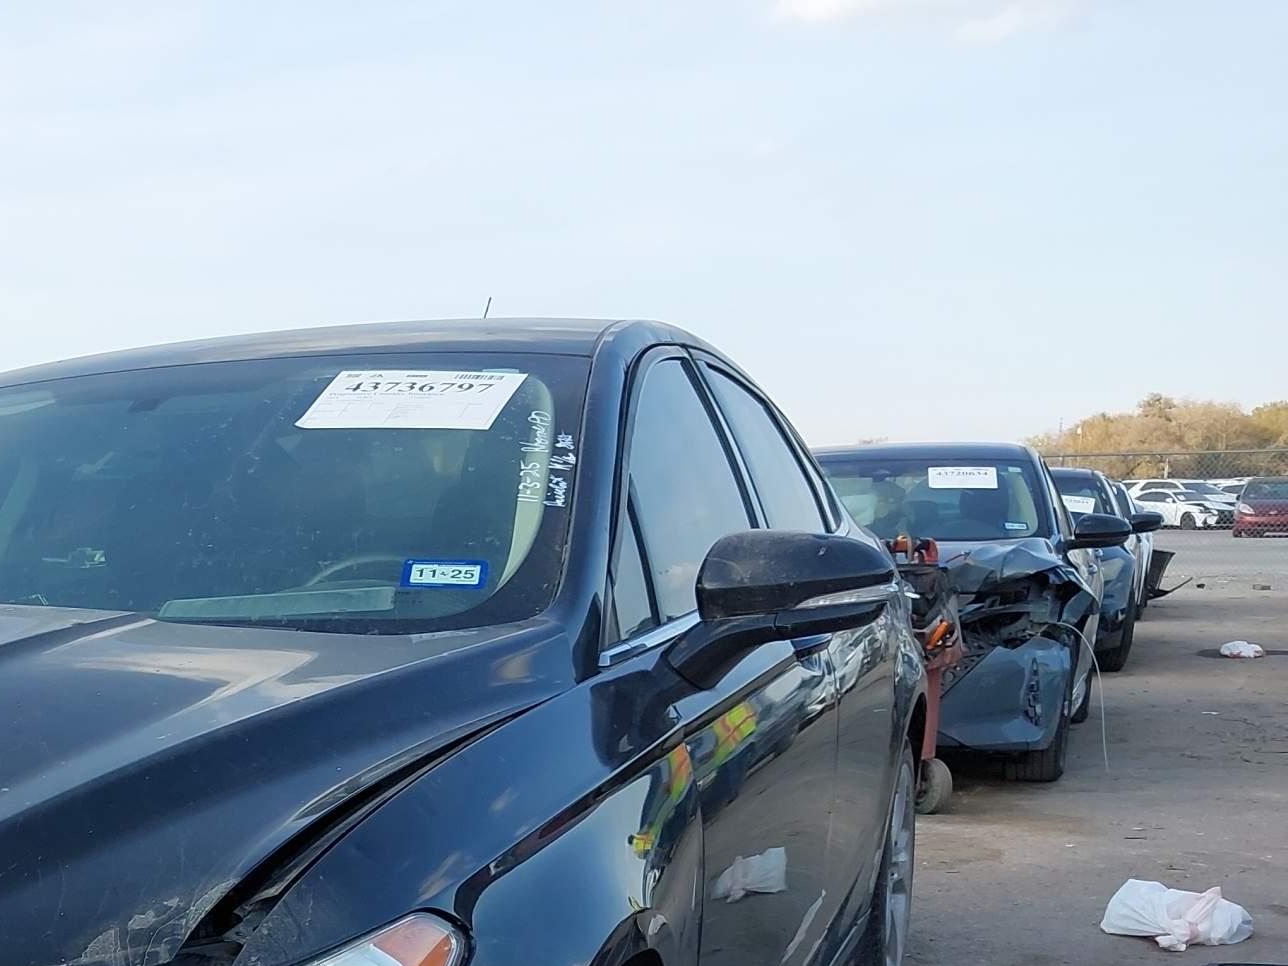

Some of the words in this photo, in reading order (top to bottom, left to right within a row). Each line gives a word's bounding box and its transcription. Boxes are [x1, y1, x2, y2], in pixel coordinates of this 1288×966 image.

[344, 381, 496, 393] 43736797
[416, 568, 437, 578] 11
[450, 569, 475, 580] 25
